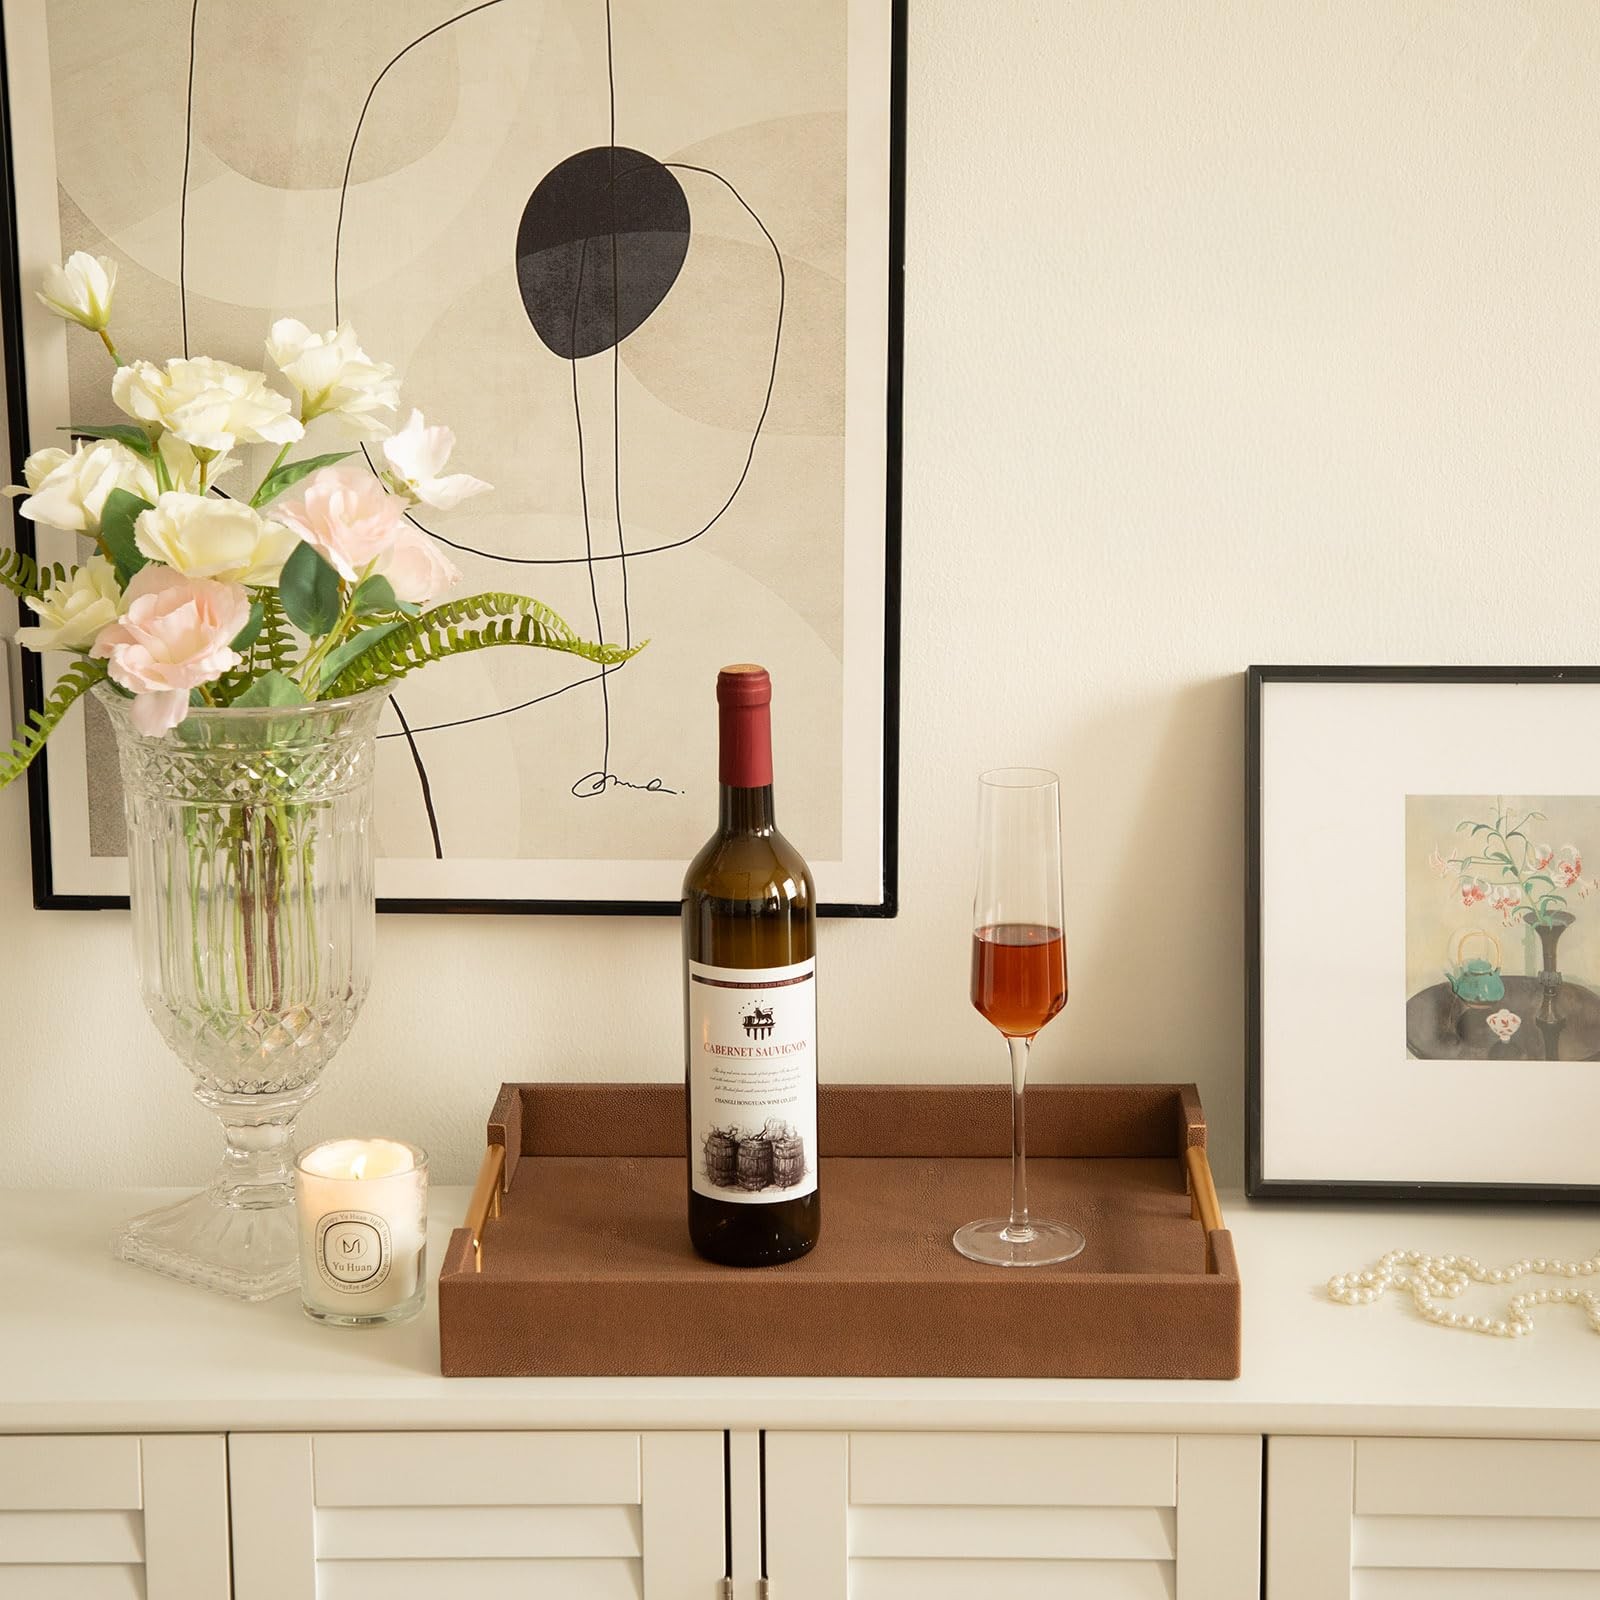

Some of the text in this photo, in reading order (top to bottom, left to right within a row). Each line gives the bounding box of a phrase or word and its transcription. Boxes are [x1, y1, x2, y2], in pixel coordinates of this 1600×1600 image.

[703, 1040, 807, 1057] CABERNET SAUVIGNON
[333, 1261, 372, 1272] Yu Huan
